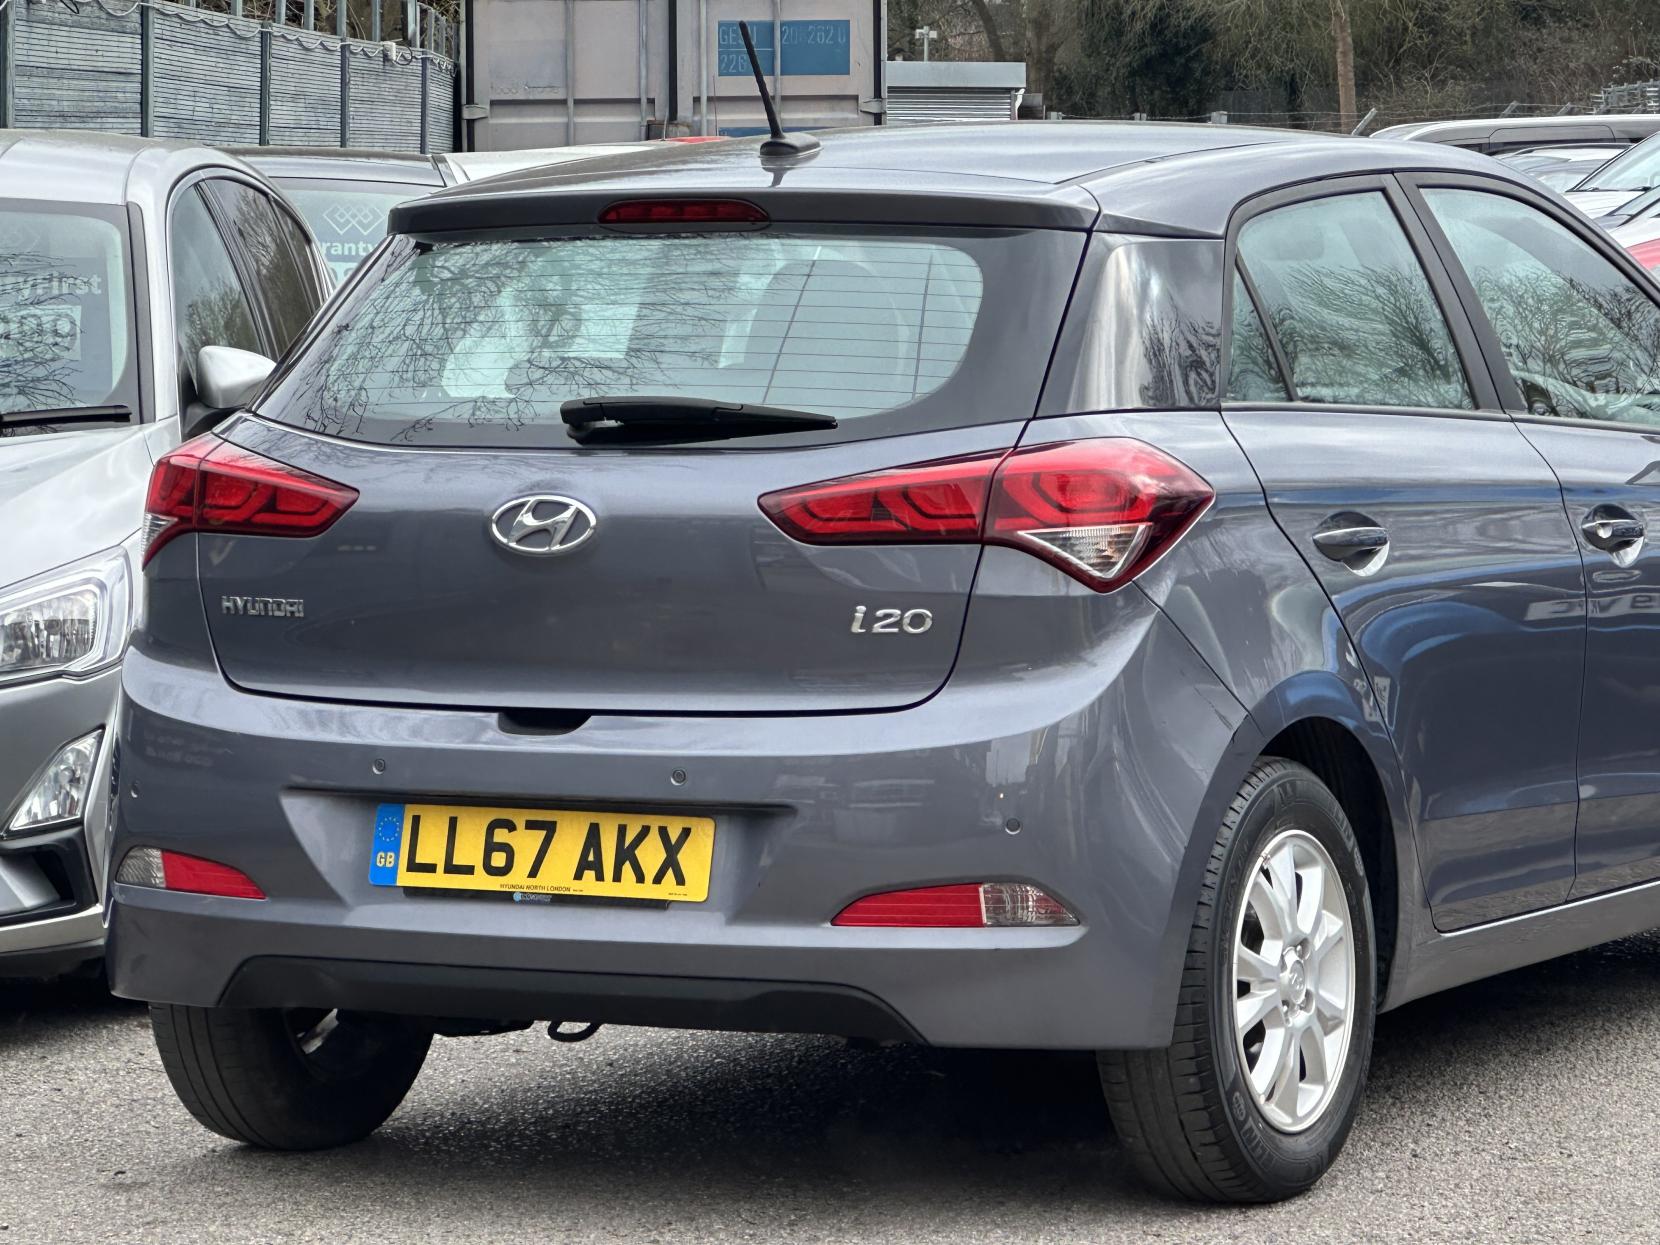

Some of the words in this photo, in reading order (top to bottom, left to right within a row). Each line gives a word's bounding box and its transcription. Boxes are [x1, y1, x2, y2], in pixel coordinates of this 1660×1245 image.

[221, 595, 305, 618] HYUNDAI
[850, 605, 933, 634] i20
[376, 852, 395, 868] GB
[405, 814, 558, 879] LL67
[573, 822, 693, 886] AKX
